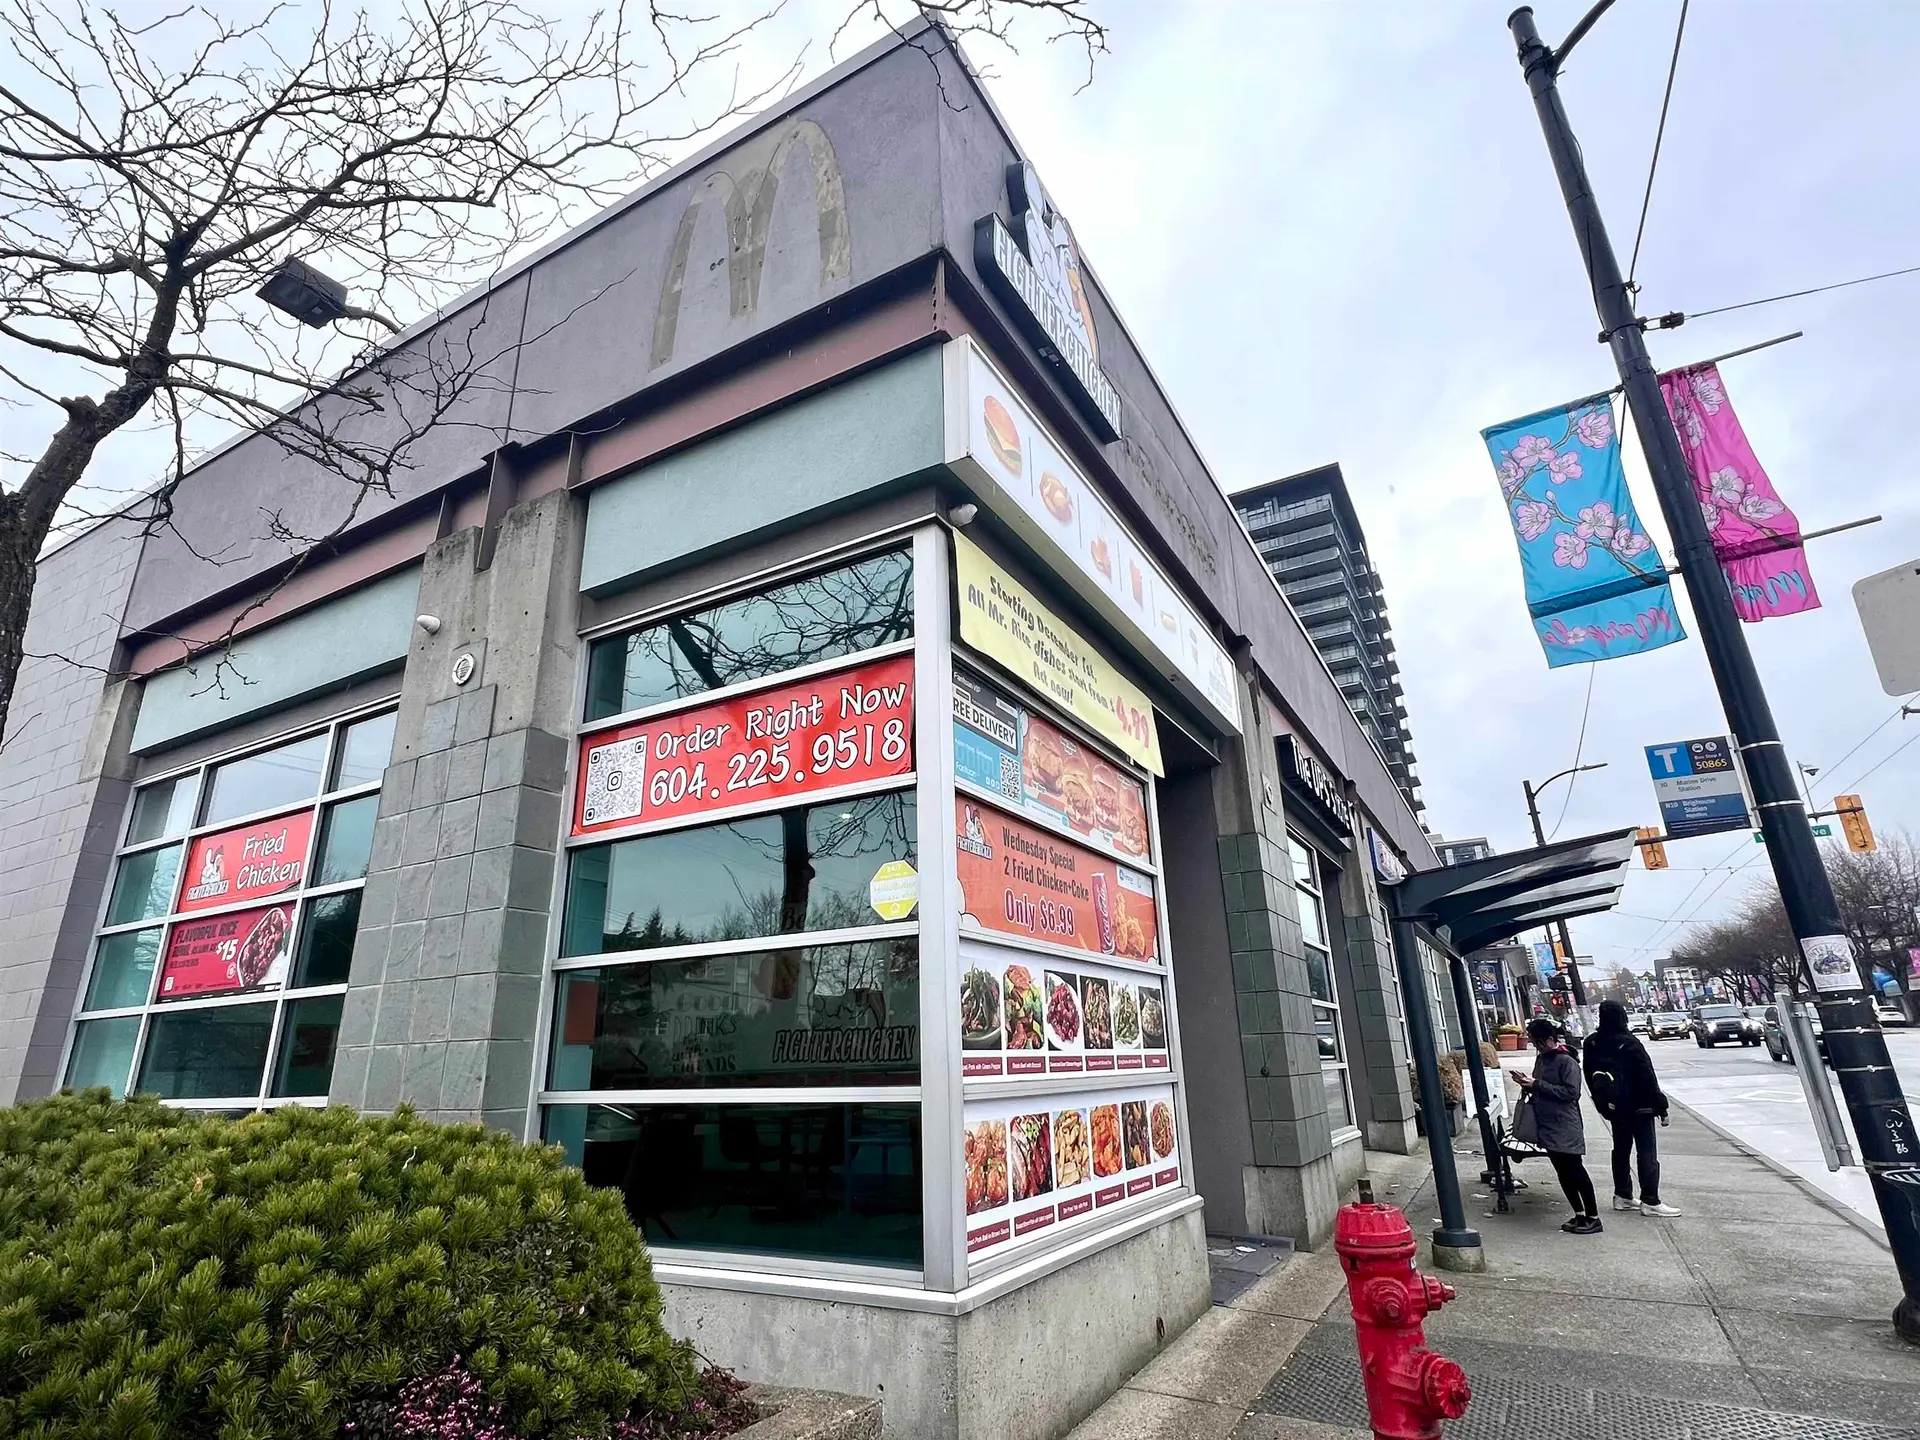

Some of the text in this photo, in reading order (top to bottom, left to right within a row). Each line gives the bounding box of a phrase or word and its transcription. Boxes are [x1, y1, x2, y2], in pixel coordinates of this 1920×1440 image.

[994, 221, 1122, 439] FIGHTERCHICKEN
[989, 576, 1035, 632] Starting
[1036, 614, 1080, 667] December
[967, 583, 985, 612] All
[988, 599, 1008, 630] Mr.
[1011, 620, 1032, 652] Rice
[1034, 636, 1066, 675] dishes
[1068, 663, 1088, 693] start
[1088, 683, 1109, 709] from
[1032, 662, 1074, 707] Act now!
[655, 682, 906, 760] Order Right Now
[953, 697, 971, 721] REE
[972, 708, 1015, 746] DELIVERY
[649, 718, 907, 807] 604.225.9518
[1654, 747, 1677, 773] T
[1695, 758, 1728, 770] 50865
[242, 828, 287, 860] Fried
[1002, 826, 1076, 873] Wednesday Special
[236, 859, 301, 891] Chicken
[1003, 855, 1010, 876] 2
[1012, 859, 1035, 885] Fried
[1036, 865, 1090, 901] Chicken+Coke
[1004, 889, 1075, 937] Only $6.99
[215, 939, 239, 961] $15
[772, 1025, 917, 1063] FIGHTERCHICKEN
